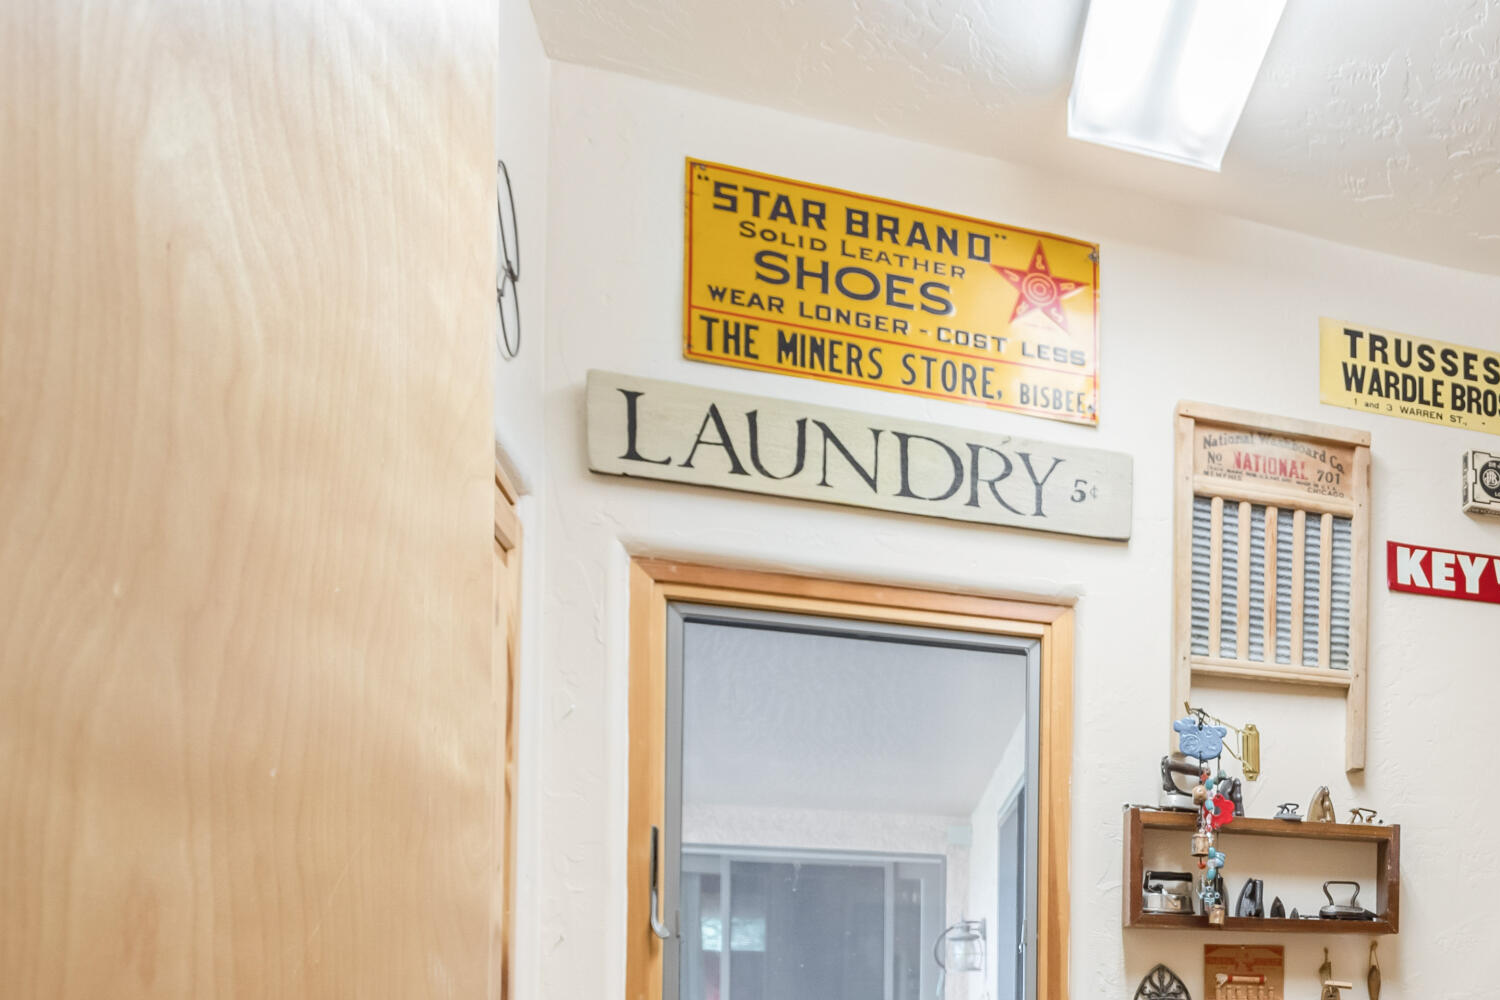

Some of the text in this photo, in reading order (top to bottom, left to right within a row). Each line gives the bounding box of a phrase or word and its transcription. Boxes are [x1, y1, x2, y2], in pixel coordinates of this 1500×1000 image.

[739, 221, 966, 280] SOLID LEATHER
[754, 250, 954, 317] SHOES
[707, 284, 1086, 367] WEAR LONGER COST LESS
[700, 315, 759, 360] THE
[777, 329, 883, 380] MINERS
[902, 354, 1003, 400] STORE,
[1342, 362, 1444, 408] WARDLE
[1343, 328, 1500, 385] TRUSSES
[1400, 406, 1443, 420] WARREN
[616, 388, 1066, 518] LAUNDRY
[1233, 451, 1308, 480] NATIONAL
[1317, 469, 1340, 485] 701
[1306, 486, 1345, 498] CHICAGO
[1396, 546, 1489, 594] KEY
